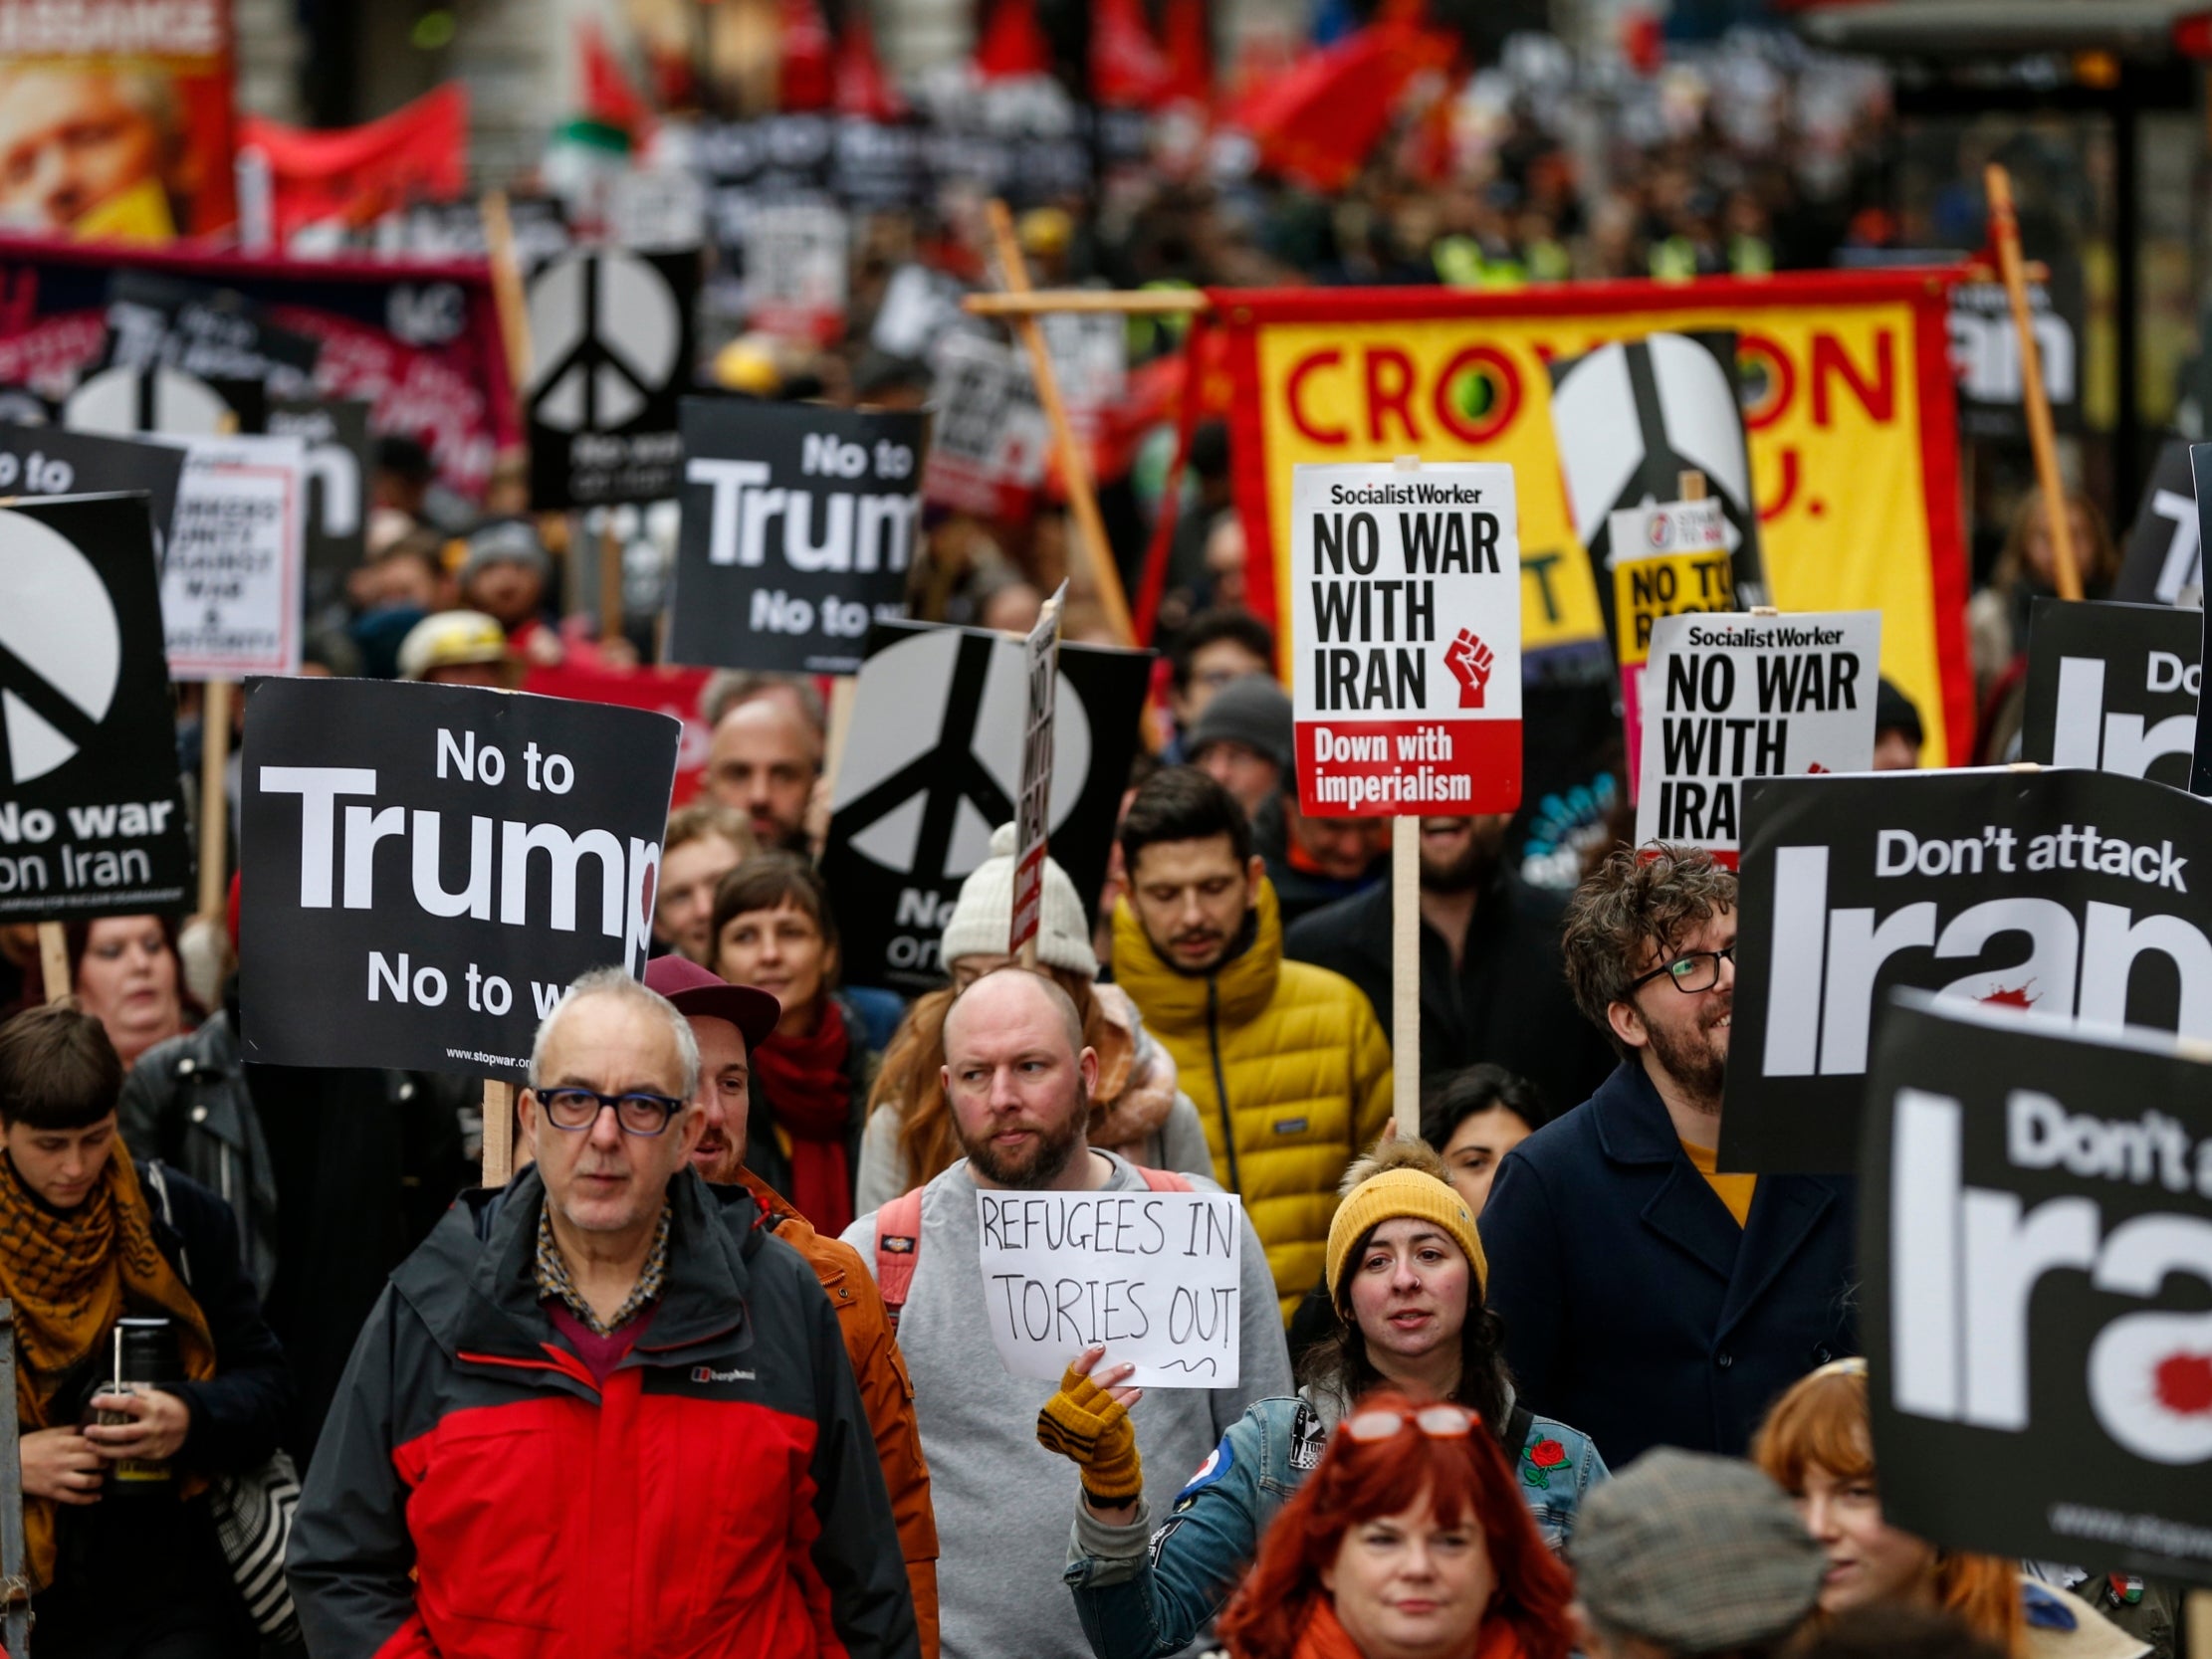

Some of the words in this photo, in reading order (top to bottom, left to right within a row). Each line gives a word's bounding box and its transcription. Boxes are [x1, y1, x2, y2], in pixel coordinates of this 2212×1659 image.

[1286, 326, 1894, 446] CROON
[25, 450, 76, 494] to
[801, 431, 867, 480] No
[874, 438, 913, 481] to
[1330, 484, 1415, 506] Socialist
[1417, 484, 1482, 506] Worker
[1312, 512, 1380, 575] NO
[1400, 512, 1500, 575] WAR
[750, 587, 814, 636] No
[820, 594, 869, 638] to
[1311, 580, 1436, 643] WITH
[1632, 563, 1676, 606] NO
[1688, 626, 1774, 648] Socialist
[1776, 626, 1844, 646] Worker
[1314, 648, 1427, 711] IRAN
[1665, 653, 1735, 713] NO
[1757, 652, 1860, 714] WAR
[437, 727, 506, 786] No
[523, 741, 575, 795] to
[1314, 726, 1388, 762] Down
[1397, 726, 1452, 762] with
[1662, 718, 1788, 776] WITH
[1314, 766, 1471, 809] imperialism
[1659, 781, 1737, 840] IRA
[0, 801, 57, 844] No
[67, 799, 174, 841] war
[0, 855, 49, 893] on
[61, 843, 151, 890] Iran
[259, 765, 662, 980] Trump
[1876, 825, 2017, 877] Don't
[2026, 824, 2188, 893] attack
[367, 950, 448, 1007] No
[465, 963, 513, 1016] to
[1762, 845, 2212, 1077] Iran
[2005, 1088, 2191, 1192] Don't
[982, 1196, 1165, 1255] REFUGEES
[1183, 1200, 1233, 1258] IN
[992, 1273, 1149, 1347] TORIES
[1169, 1285, 1237, 1349] OUT
